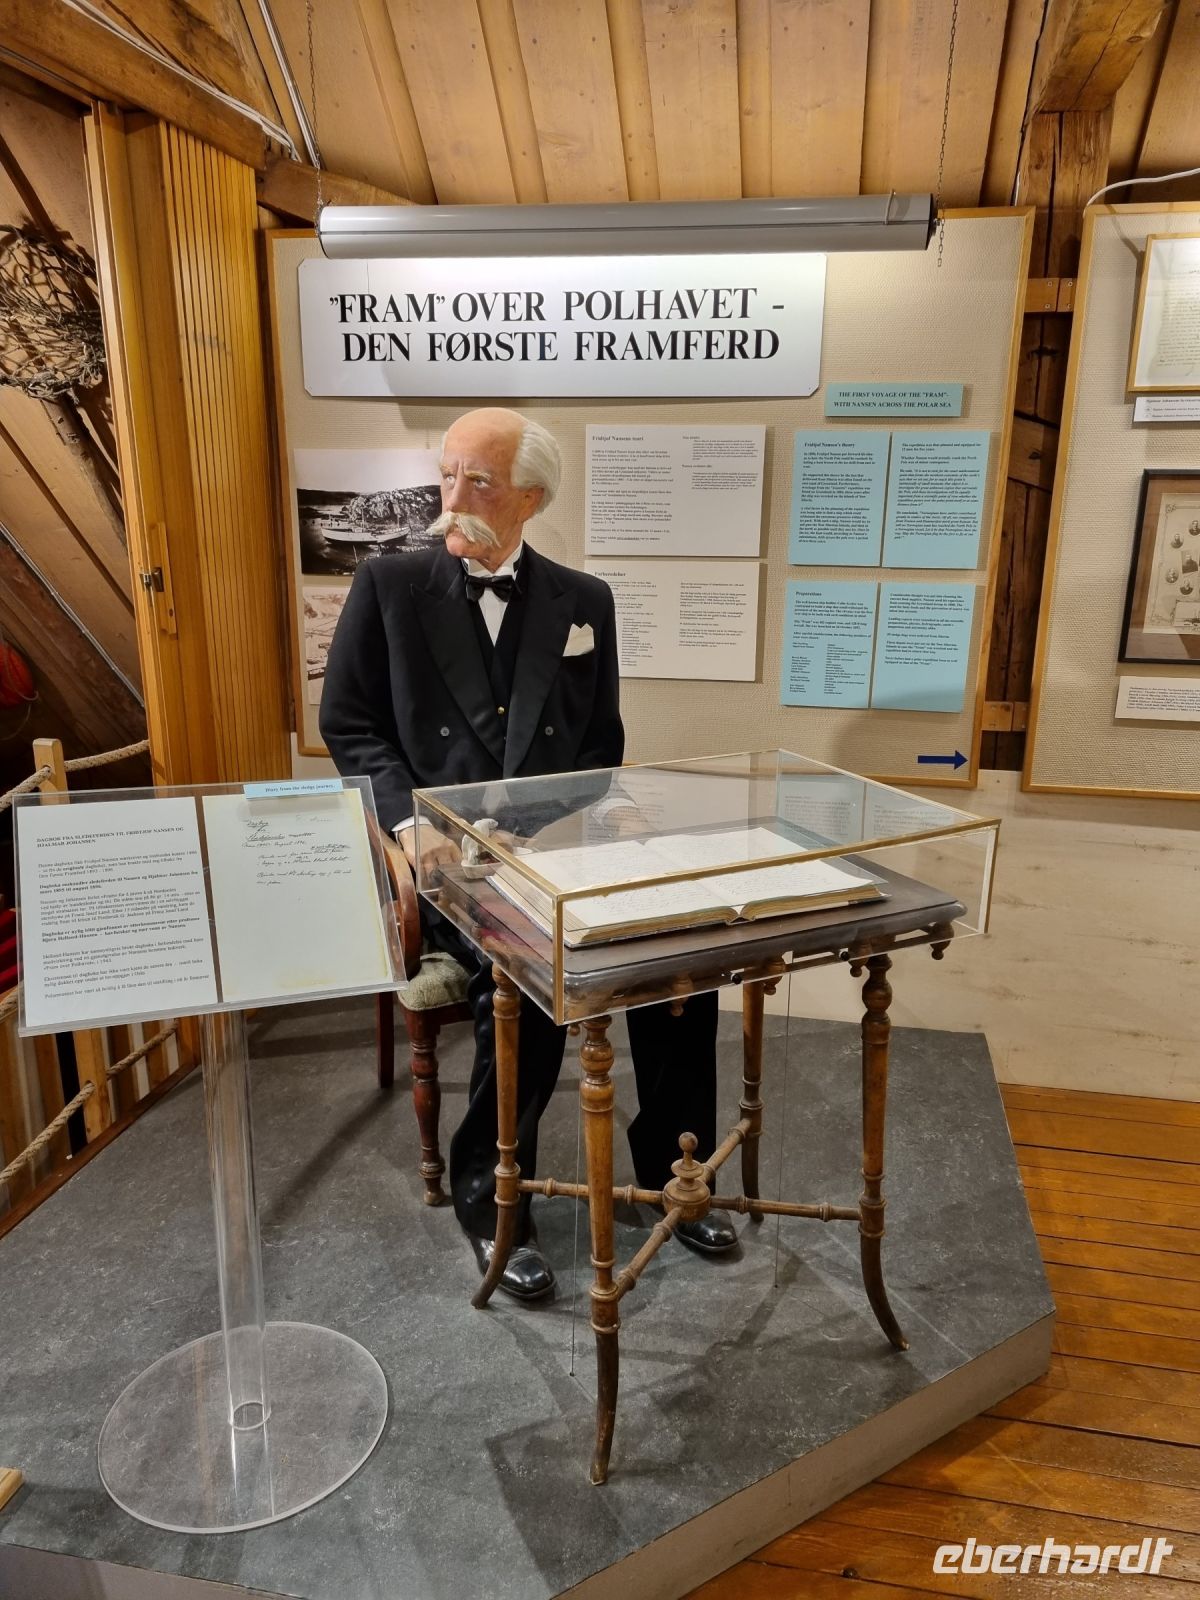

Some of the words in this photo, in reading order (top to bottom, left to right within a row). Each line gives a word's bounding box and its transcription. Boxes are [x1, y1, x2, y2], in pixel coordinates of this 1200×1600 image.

[452, 292, 546, 323] OVER
[563, 287, 759, 321] POLHAVET
[342, 332, 411, 362] DEN
[426, 330, 559, 362] FØRSTE
[574, 328, 780, 361] FRAMFERD
